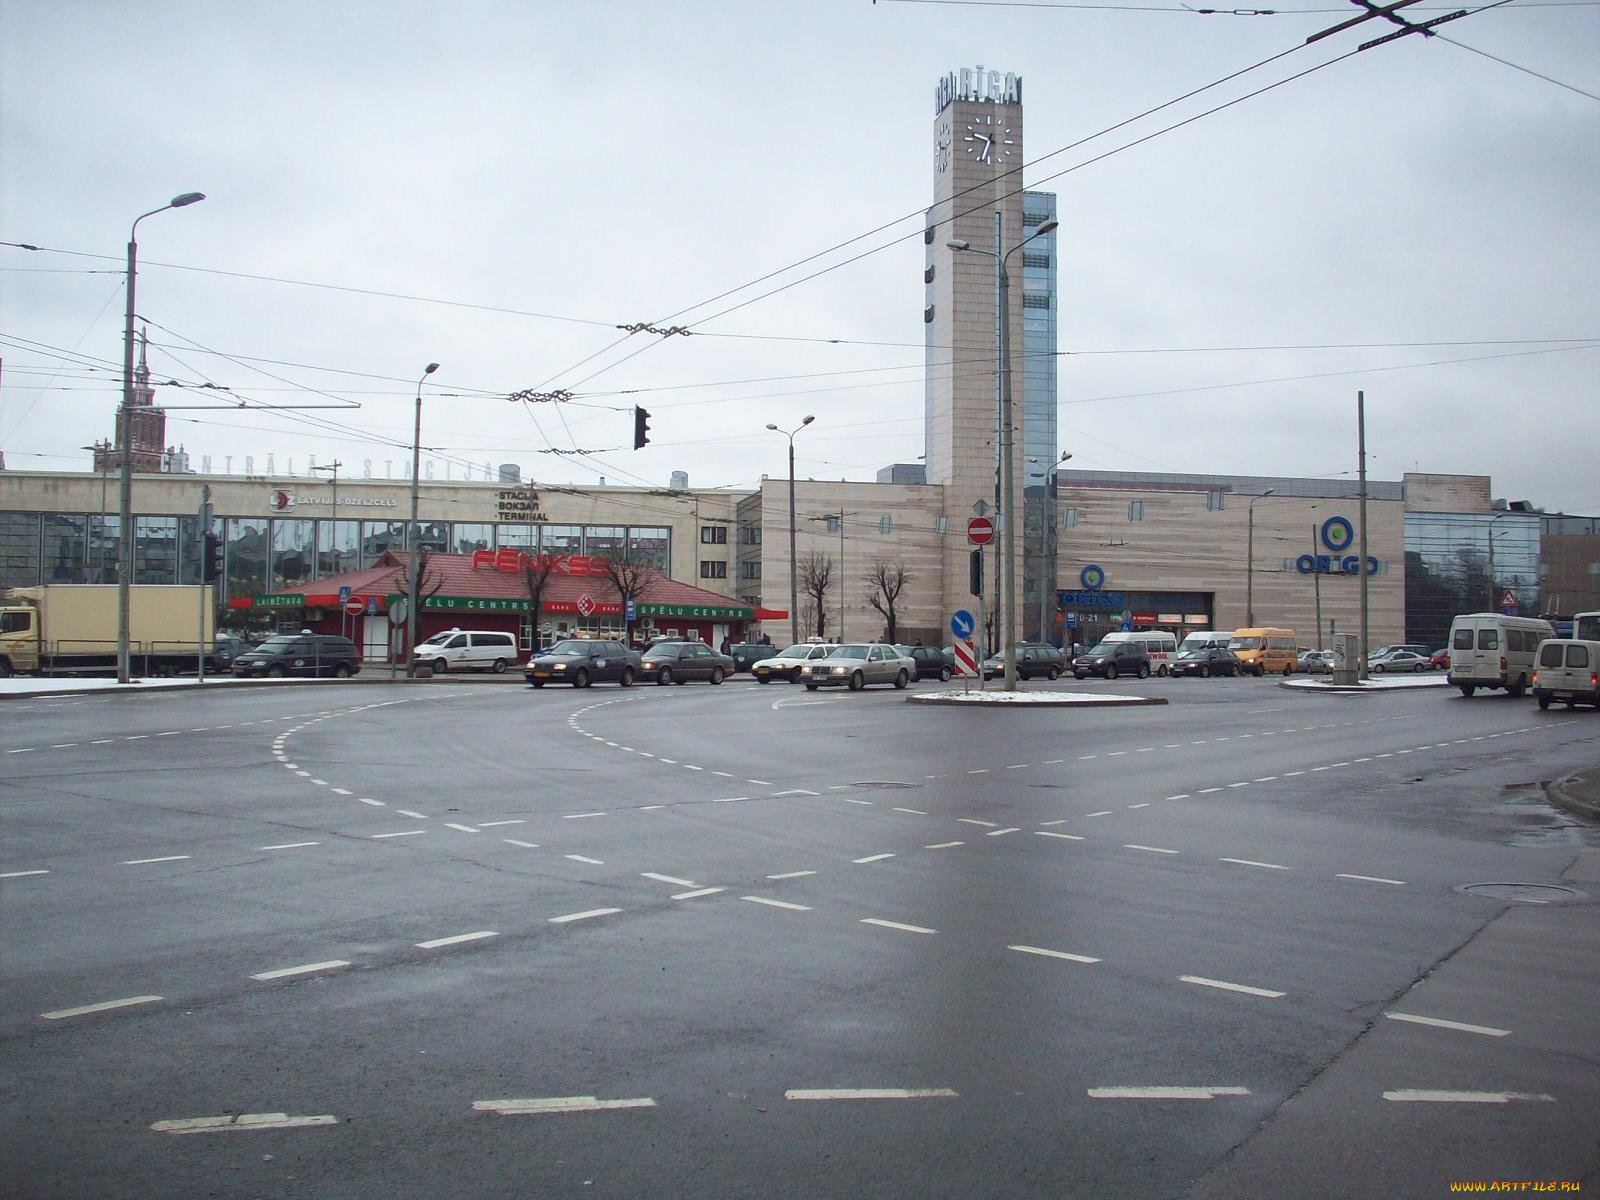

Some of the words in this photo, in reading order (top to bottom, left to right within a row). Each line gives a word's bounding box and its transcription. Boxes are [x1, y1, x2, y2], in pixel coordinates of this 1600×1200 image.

[960, 64, 1019, 102] RĪGA
[363, 458, 493, 481] STACIJA
[498, 511, 549, 521] TERMINAL
[402, 597, 455, 609] SĒLU
[694, 608, 743, 618] CENTRS
